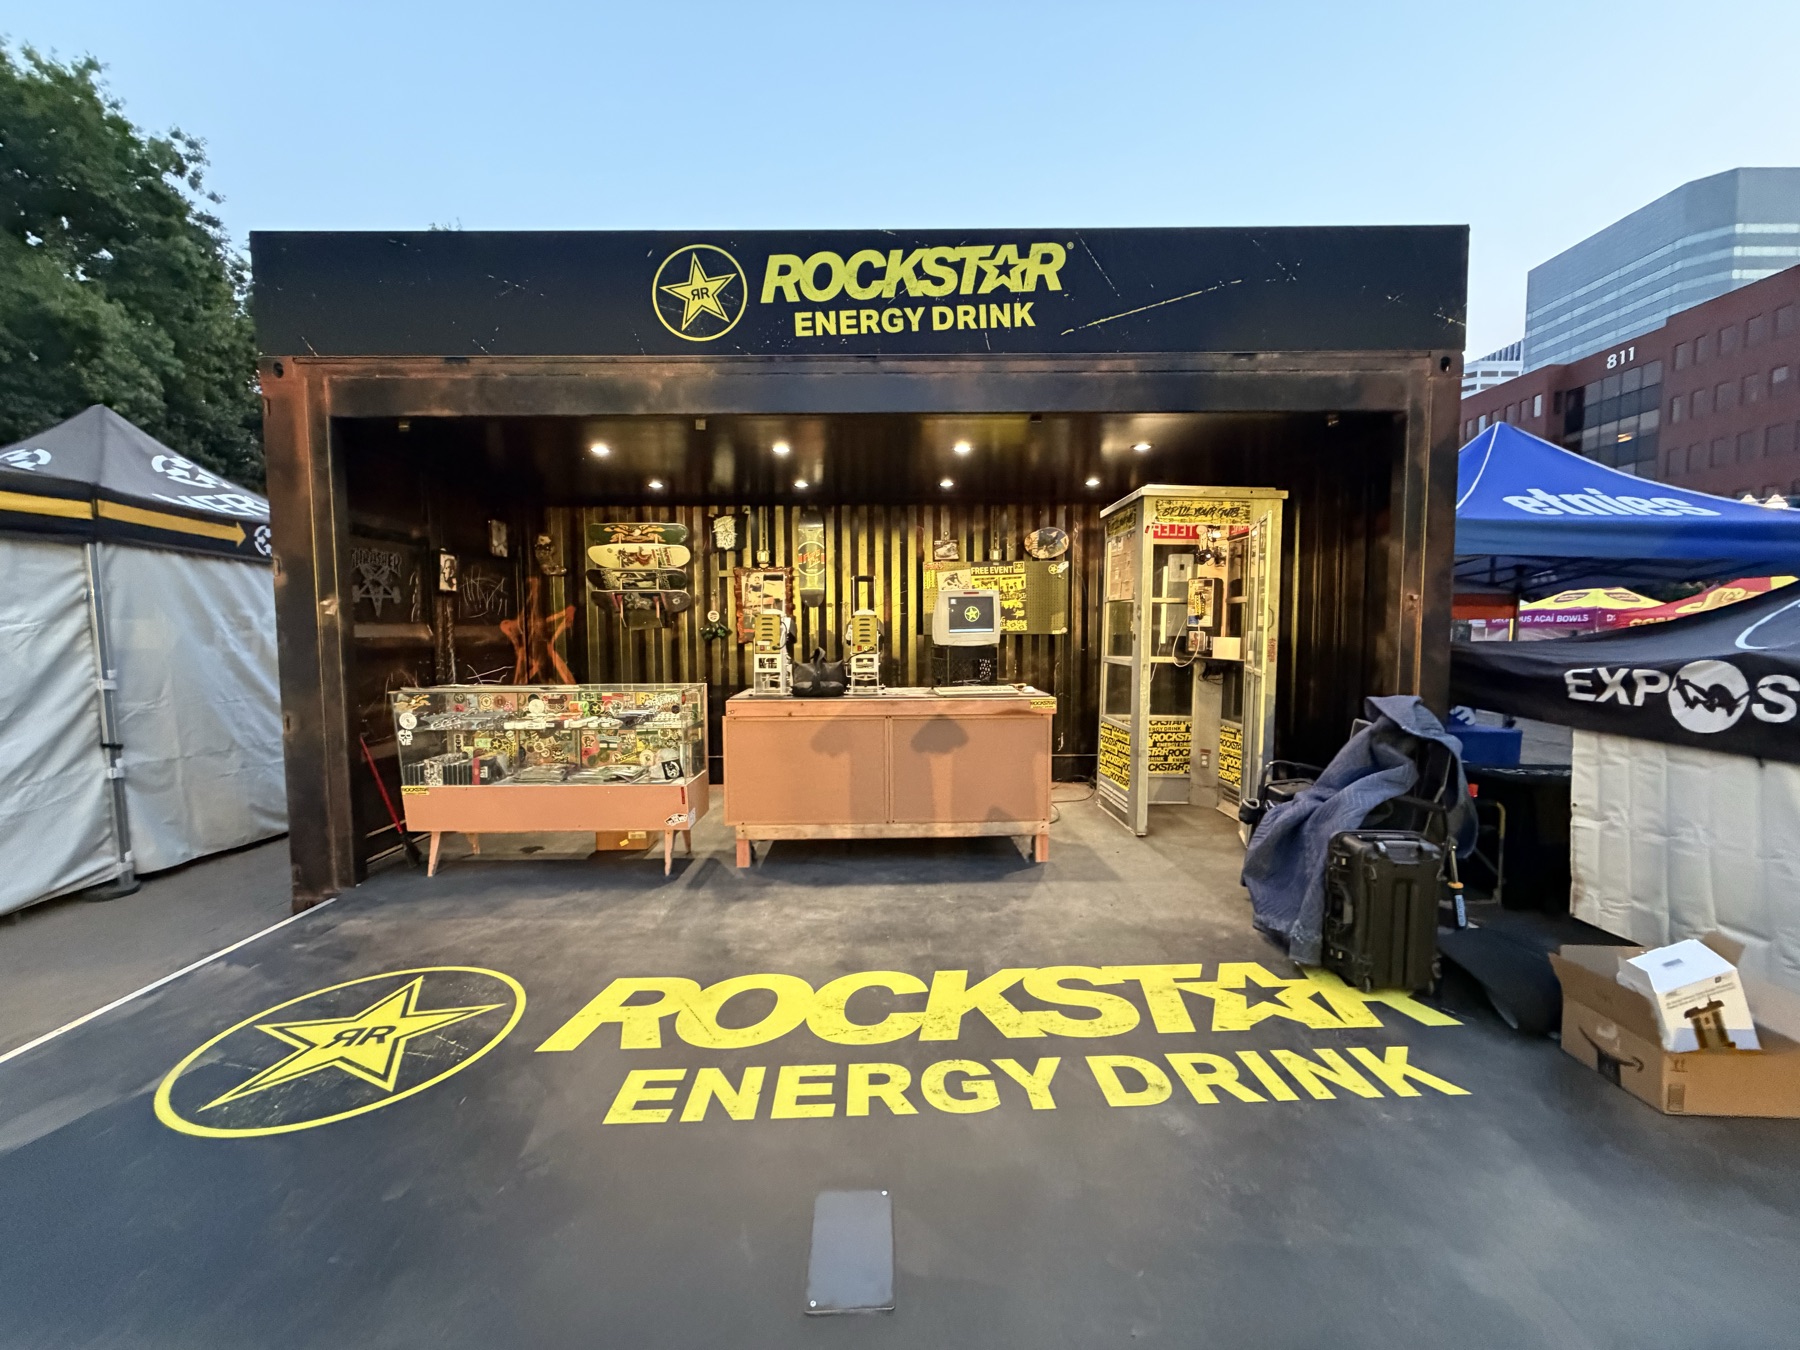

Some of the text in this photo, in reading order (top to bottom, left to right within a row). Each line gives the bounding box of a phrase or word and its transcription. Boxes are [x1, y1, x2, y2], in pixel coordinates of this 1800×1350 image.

[794, 302, 1037, 338] ENERGY DRINK
[1606, 347, 1635, 370] 811
[1194, 506, 1216, 517] YOUR
[1502, 488, 1722, 516] etnies
[971, 566, 990, 575] FREE
[990, 565, 1013, 575] EVENT
[1556, 614, 1589, 623] BOWLS
[602, 1046, 1473, 1125] ENERGY DRINK
